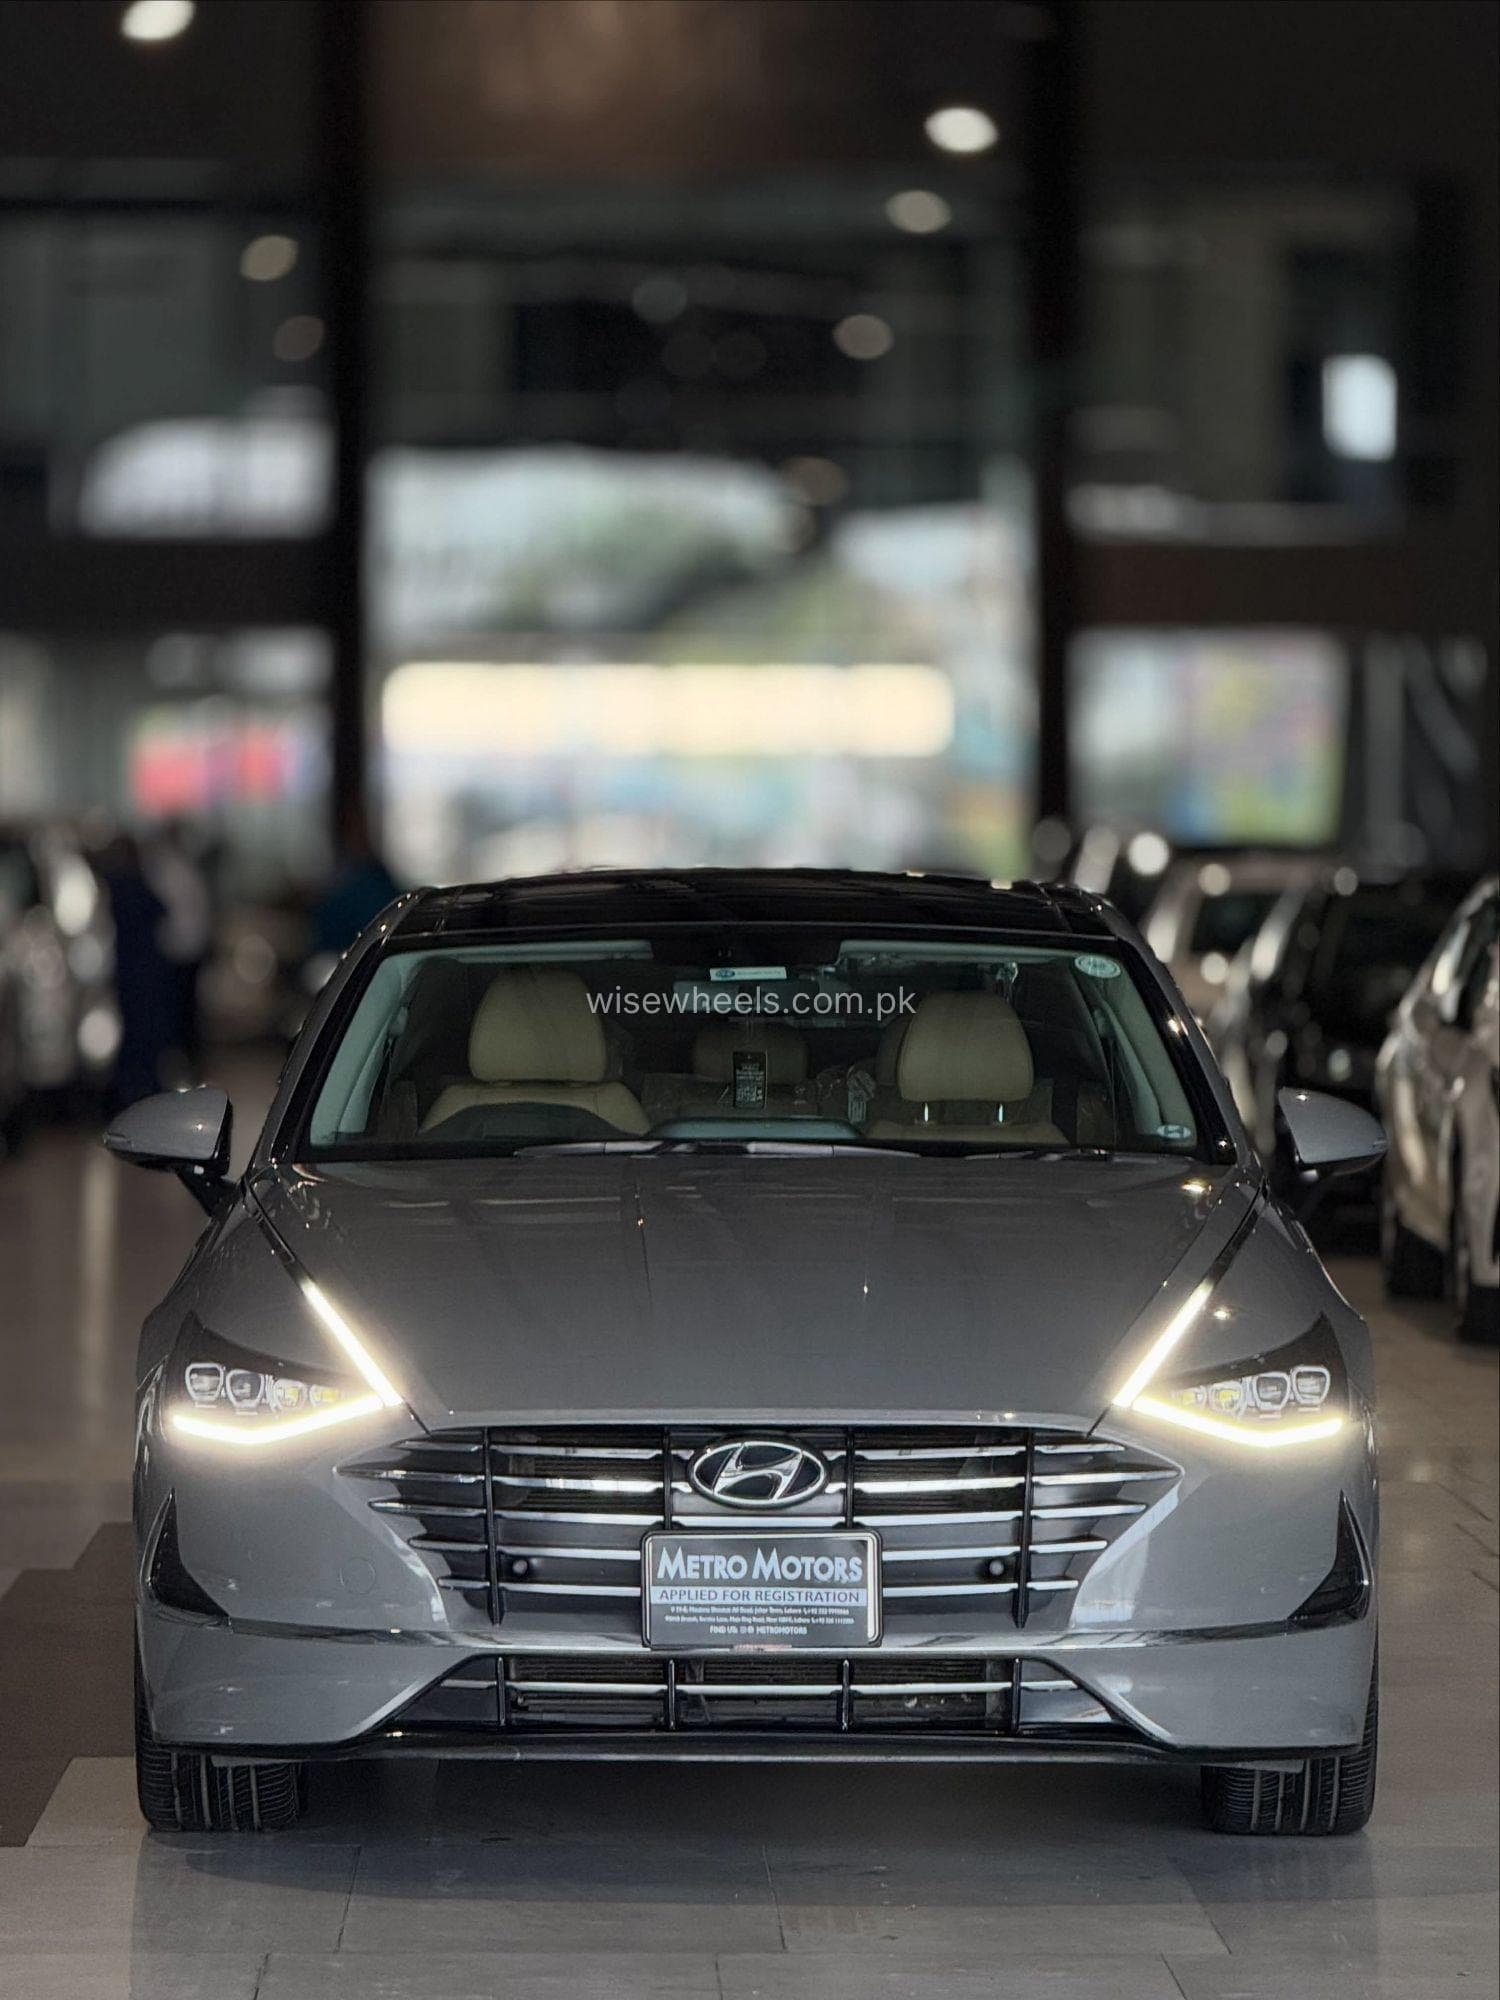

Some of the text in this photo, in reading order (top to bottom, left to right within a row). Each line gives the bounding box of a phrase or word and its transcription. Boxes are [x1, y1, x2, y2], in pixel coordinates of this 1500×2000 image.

[657, 1546, 863, 1583] METRO MOTORS
[659, 1589, 860, 1603] APPLIED FOR REGISTRATION
